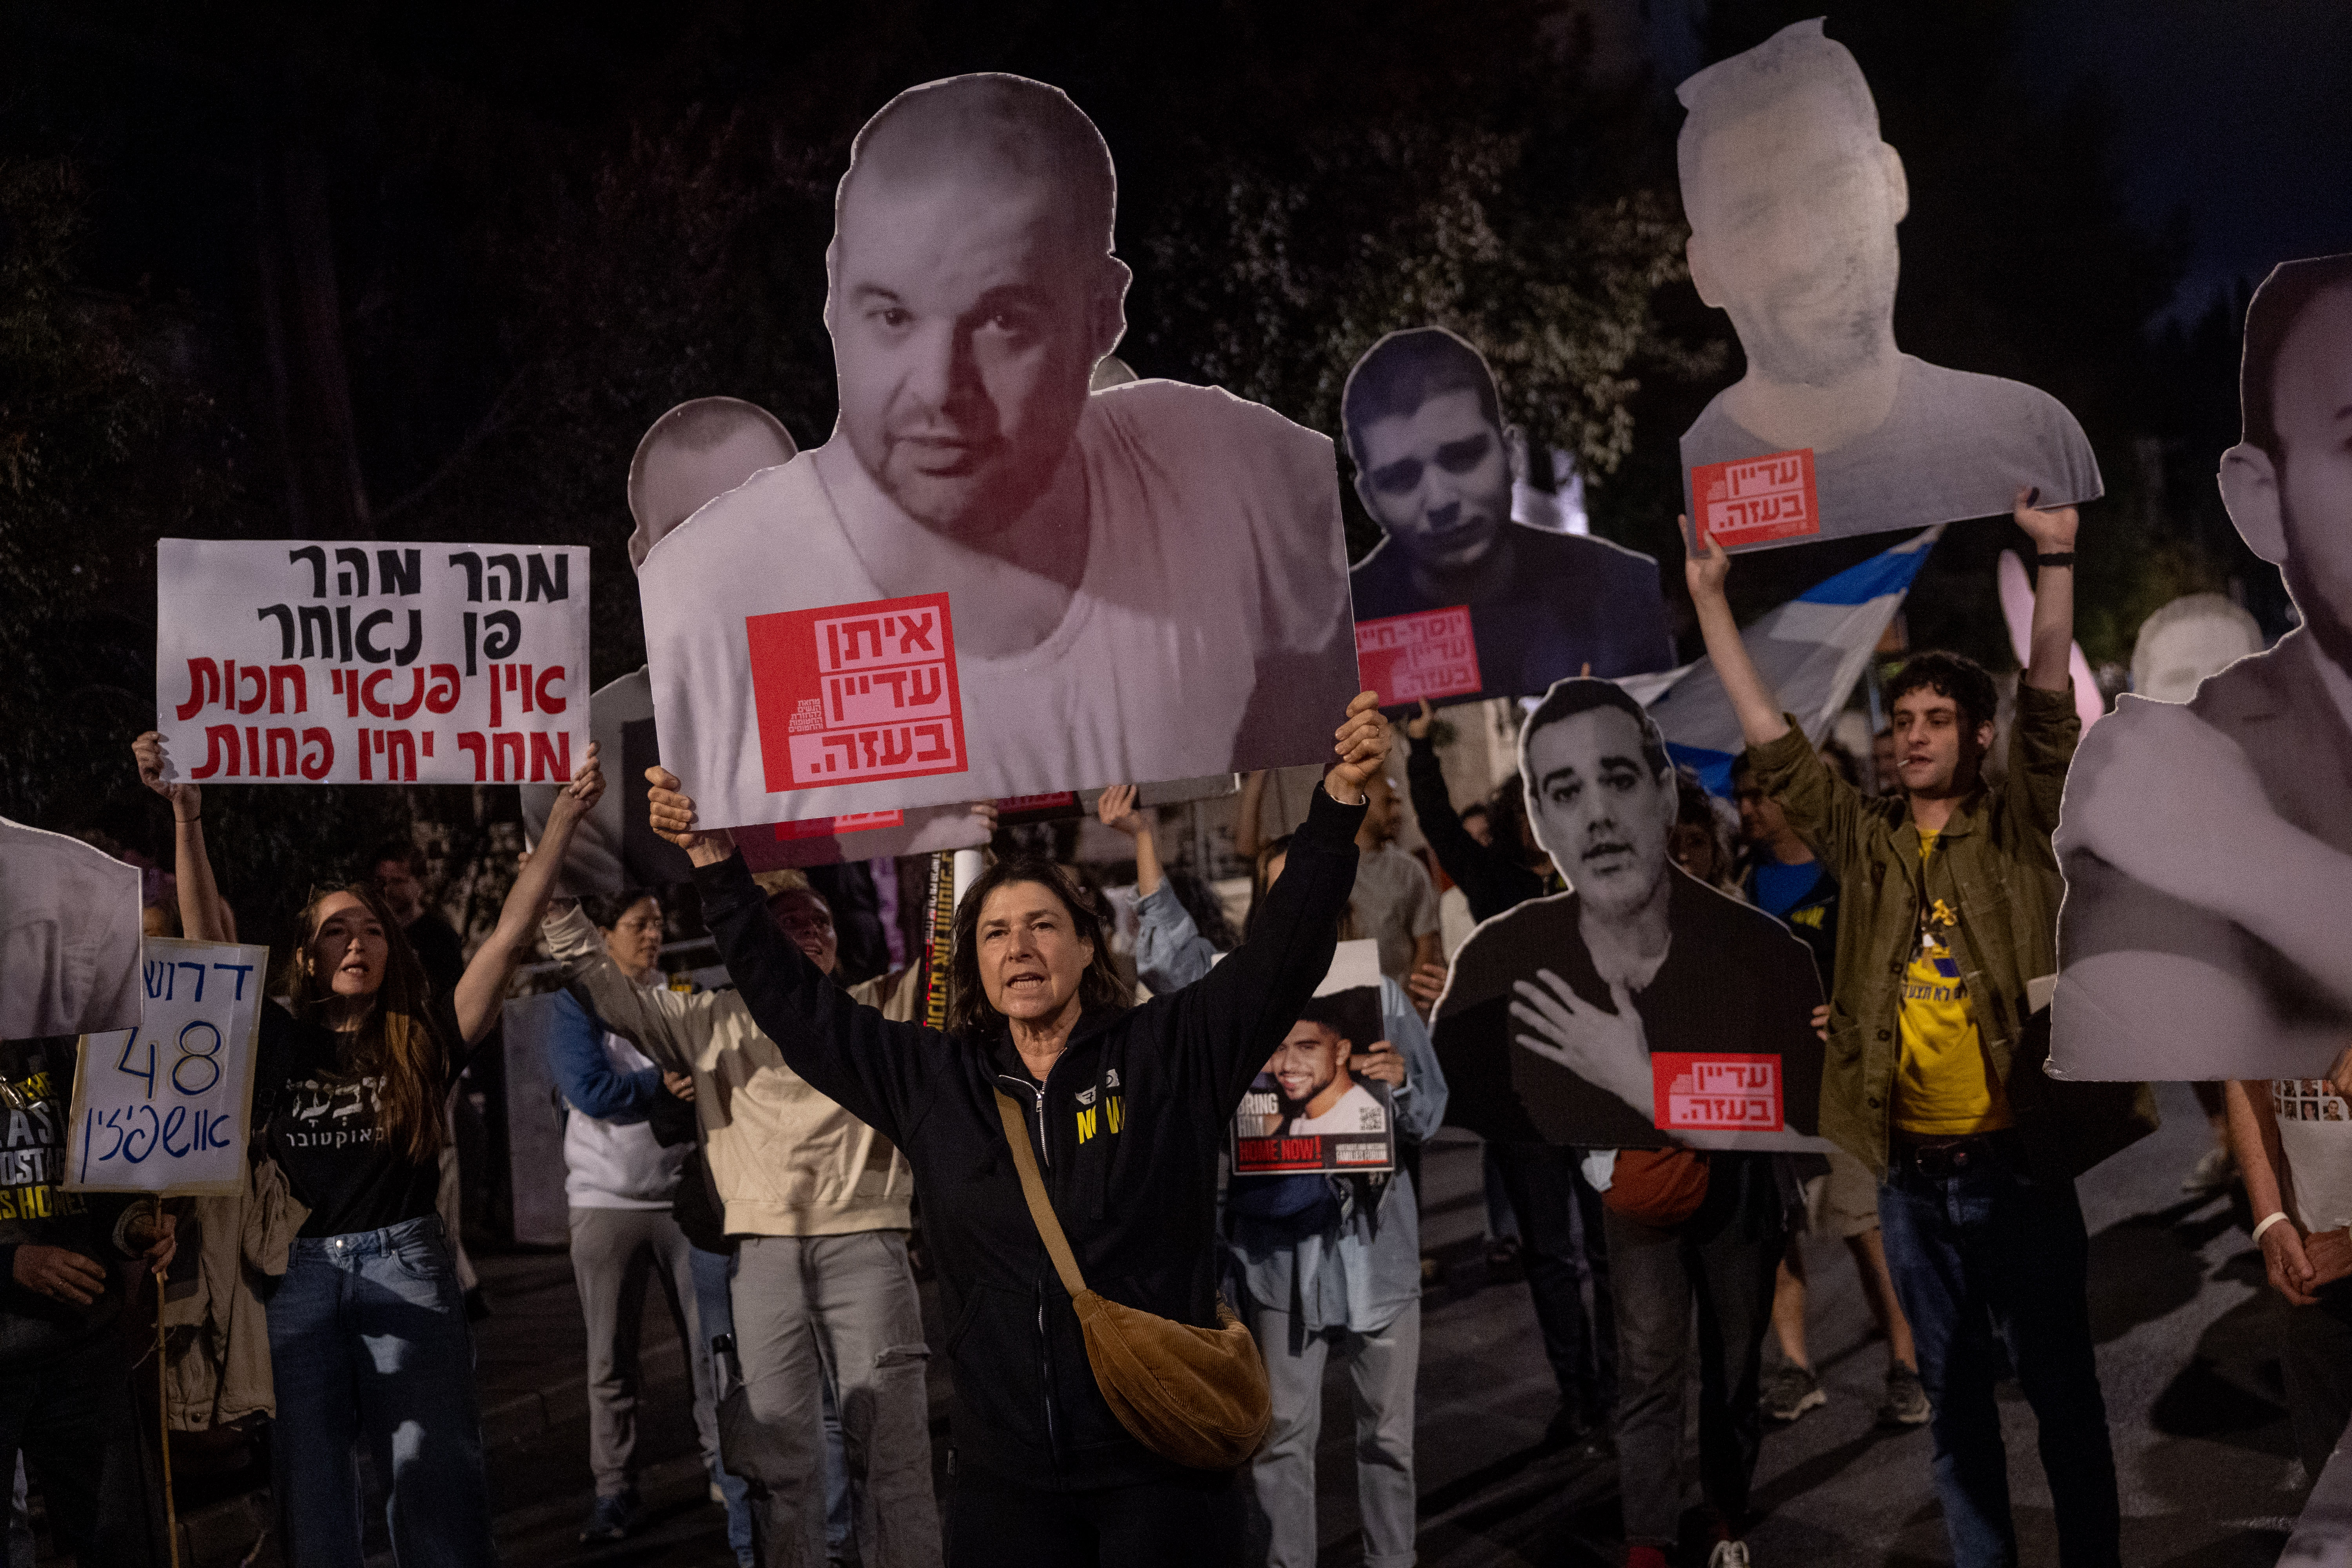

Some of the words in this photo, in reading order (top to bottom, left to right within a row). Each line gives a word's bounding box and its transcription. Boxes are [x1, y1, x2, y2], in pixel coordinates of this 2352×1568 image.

[1732, 460, 1798, 495] עדיין
[1719, 494, 1804, 528] בעזה.
[289, 546, 421, 598] מהר
[448, 551, 568, 603] מהר
[463, 610, 521, 677] פן
[826, 612, 935, 669] איתן
[1412, 637, 1467, 668] עדיין
[176, 656, 308, 721] חכות
[330, 663, 460, 720] פנאי
[488, 663, 566, 728] אין
[830, 666, 942, 722] עדיין
[191, 724, 334, 780] פחות
[358, 728, 434, 781] יחיו
[457, 731, 571, 782] מחר
[810, 723, 951, 774] בעזה.
[118, 1020, 221, 1098] 48
[1698, 1066, 1767, 1091] עדיין
[0, 1100, 68, 1148] AST
[1682, 1099, 1771, 1121] בעזה.
[1239, 1138, 1278, 1161] HOME
[1281, 1136, 1321, 1161] NOW!
